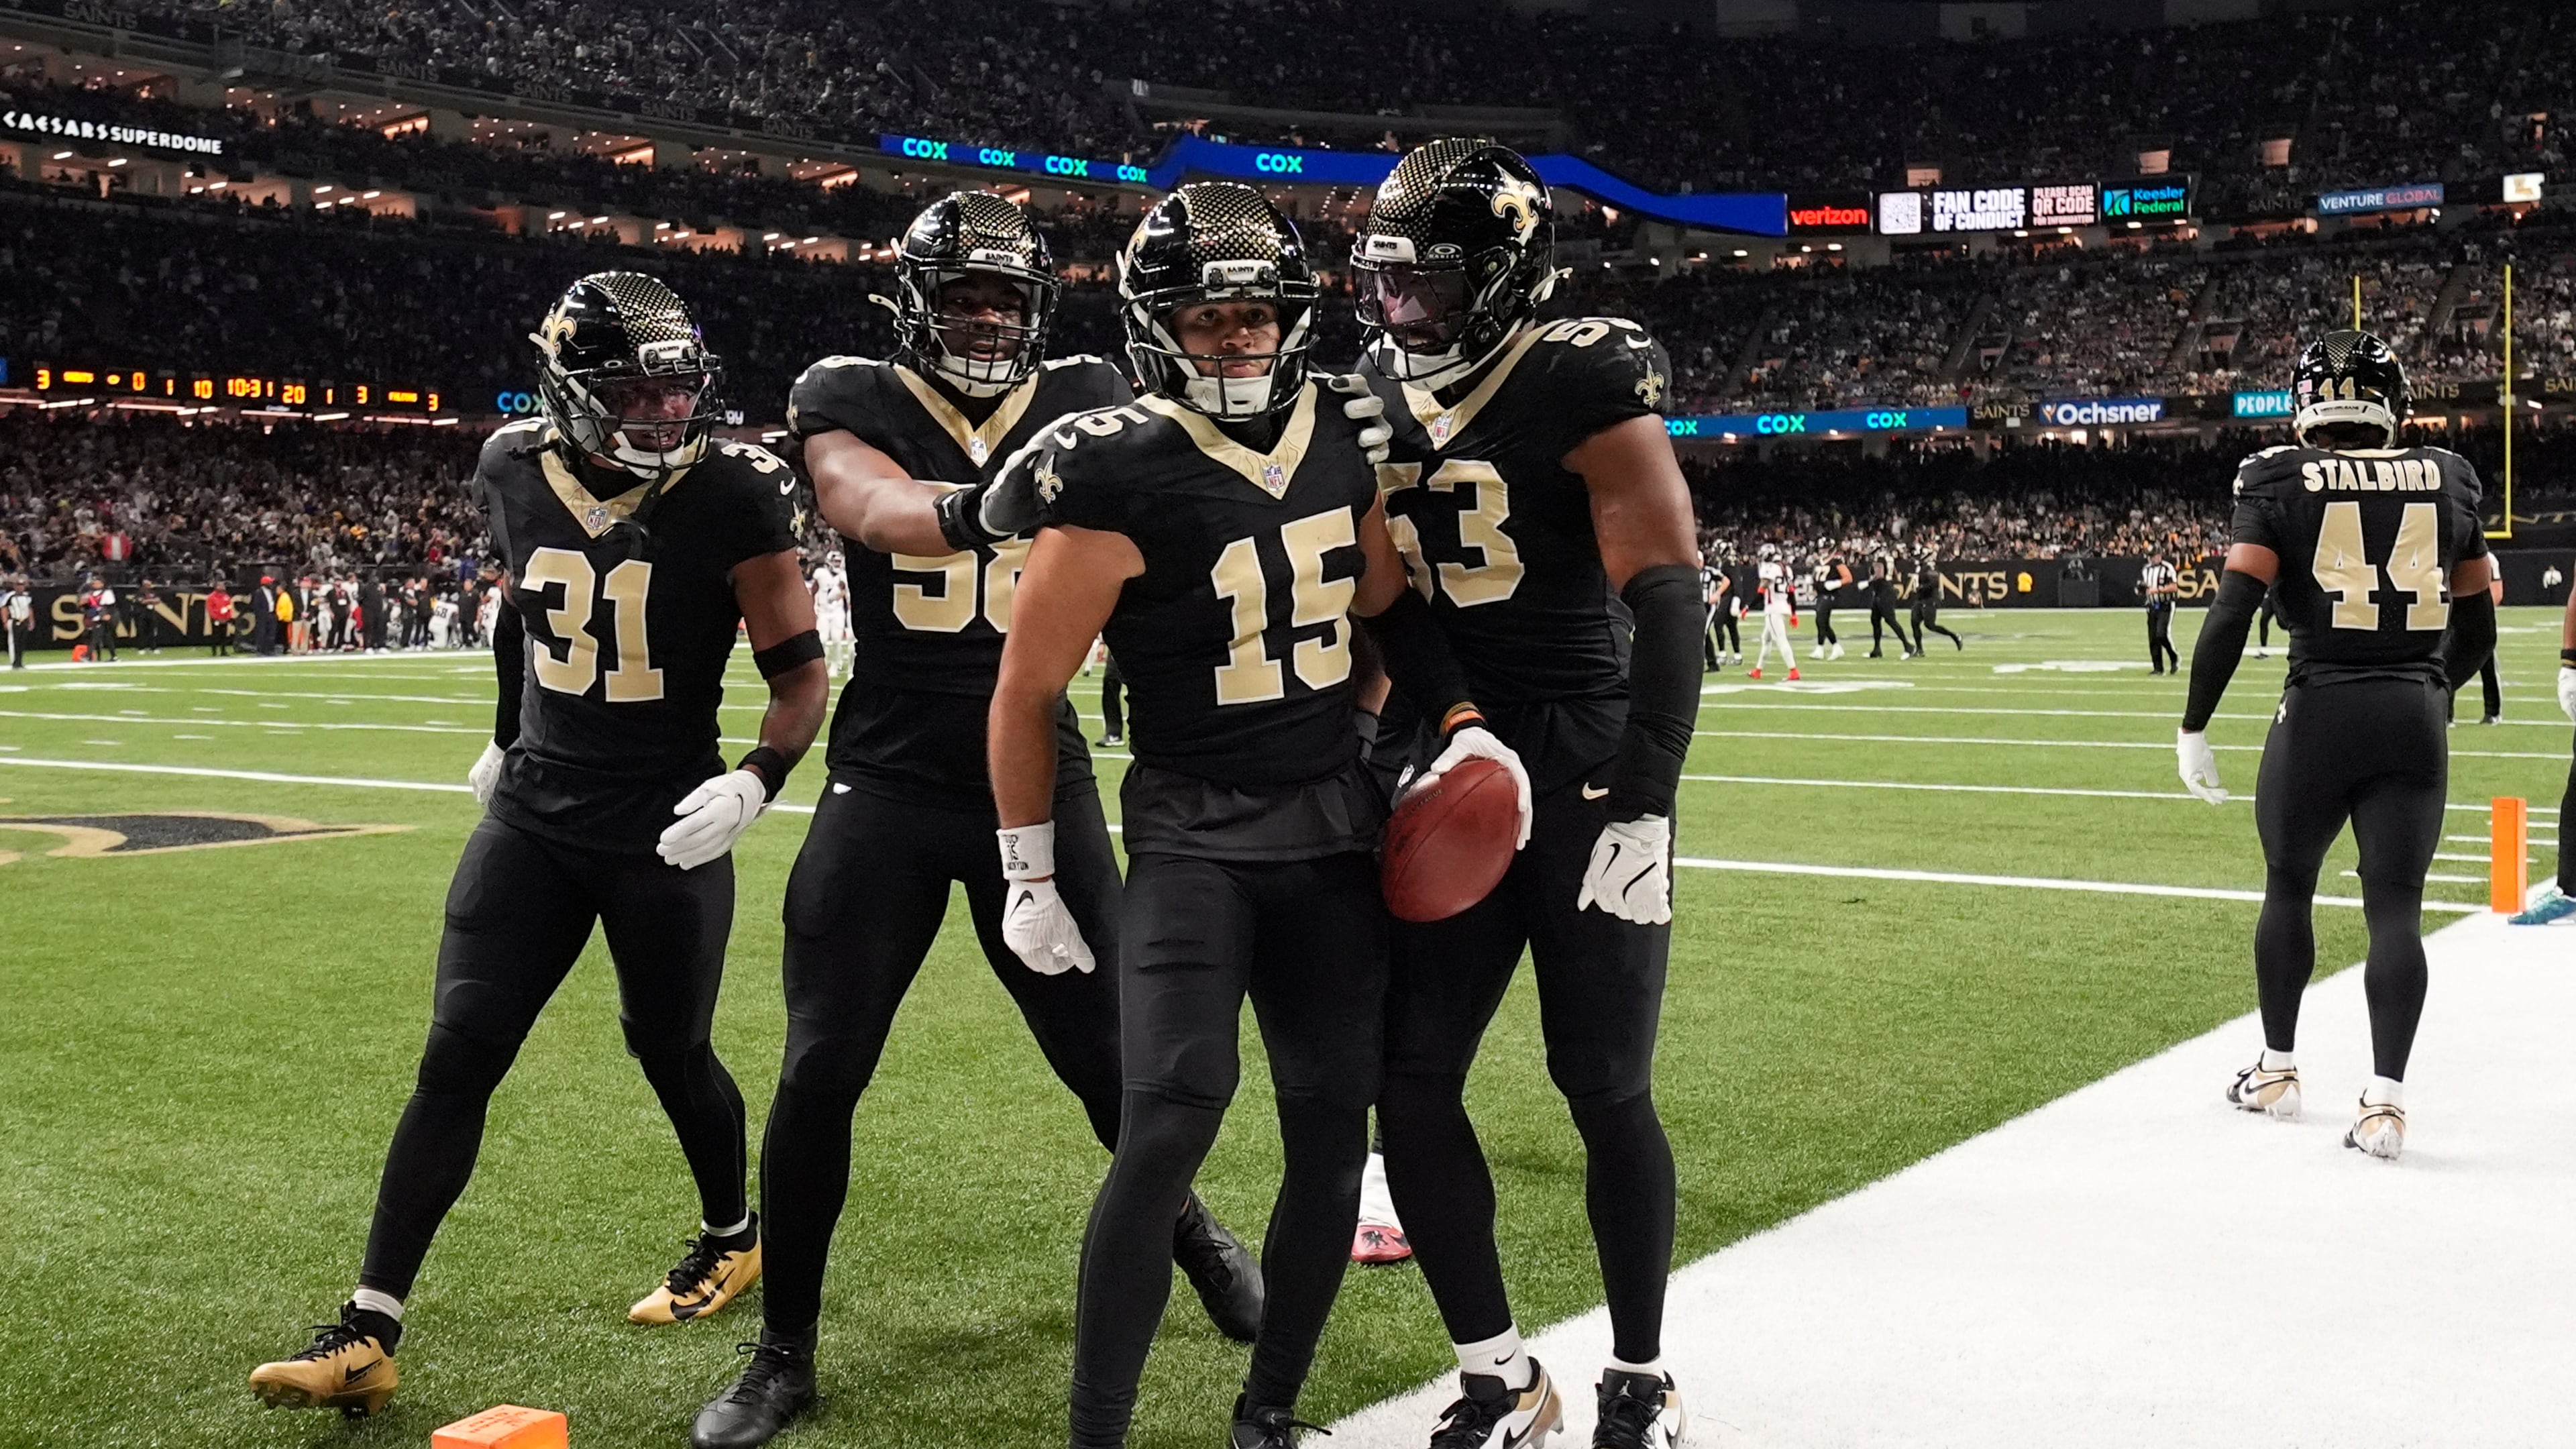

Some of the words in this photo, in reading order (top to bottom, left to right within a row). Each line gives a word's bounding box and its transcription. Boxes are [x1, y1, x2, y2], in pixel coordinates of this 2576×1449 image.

[2, 111, 109, 140] CAESARS
[110, 125, 223, 154] SUPERDOME
[902, 138, 948, 160] COX
[979, 148, 1016, 167] COX
[1044, 155, 1088, 177] COX
[1256, 152, 1303, 173] COX
[1117, 164, 1148, 182] COX
[1933, 191, 1971, 213] FAN
[1972, 189, 2025, 212] CODE
[2033, 186, 2067, 199] PLEASE
[2068, 184, 2094, 197] SCAN
[2133, 186, 2186, 201] Keesler
[2320, 193, 2383, 210] VENTURE
[2385, 189, 2440, 205] GLOBAL
[1790, 206, 1868, 226] verizon
[2033, 198, 2054, 217] QR
[2055, 195, 2095, 215] CODE
[2134, 199, 2184, 215] Federal
[1933, 213, 1954, 231] OF
[1955, 210, 2026, 231] CONDUCT
[37, 369, 50, 390] 3
[132, 372, 146, 391] 0
[166, 378, 174, 396] 1
[194, 380, 213, 399] 10
[2318, 376, 2356, 401] 44
[282, 384, 306, 405] 20
[327, 388, 333, 405] 1
[357, 386, 368, 404] 3
[2408, 384, 2460, 400] AINTS
[428, 393, 439, 412] 3
[497, 392, 543, 413] COX
[1973, 403, 2030, 420] SAINTS
[1757, 415, 1805, 433] COX
[1866, 413, 1907, 429] COX
[2057, 402, 2161, 426] Ochsner
[1269, 475, 1283, 487] NFL
[2302, 459, 2442, 492] STALBIRD
[2312, 500, 2451, 631] 44
[1210, 506, 1356, 706] 15
[520, 546, 664, 702] 31
